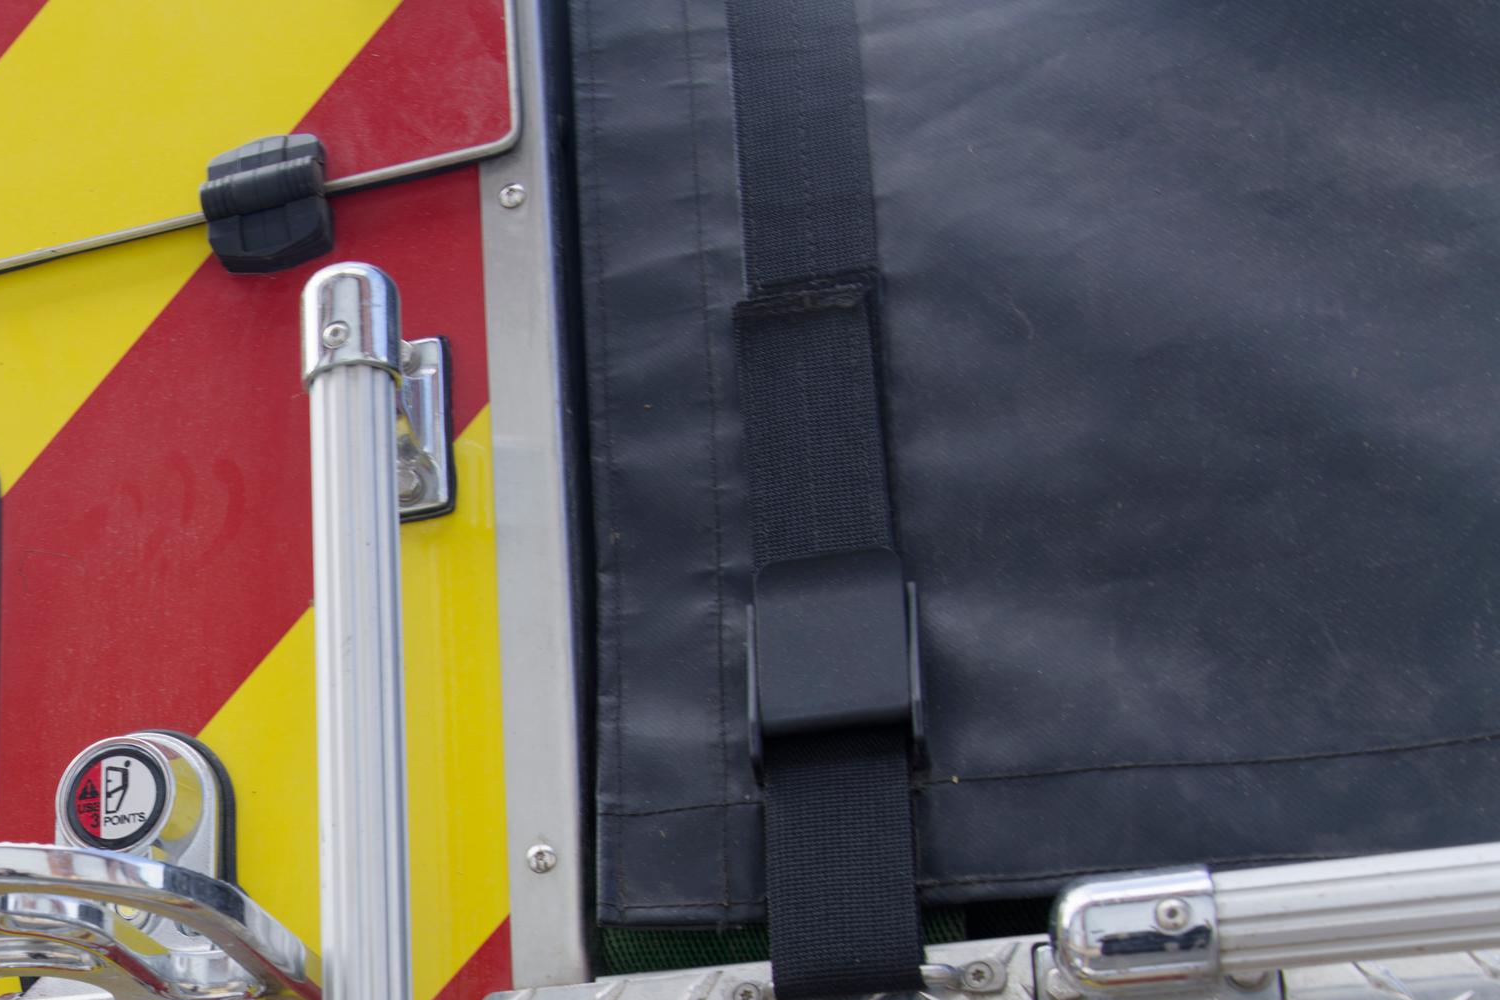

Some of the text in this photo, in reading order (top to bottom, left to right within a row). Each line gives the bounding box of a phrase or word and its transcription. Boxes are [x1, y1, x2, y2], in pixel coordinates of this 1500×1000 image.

[77, 802, 100, 814] USE
[91, 812, 146, 829] 3 POINTS
